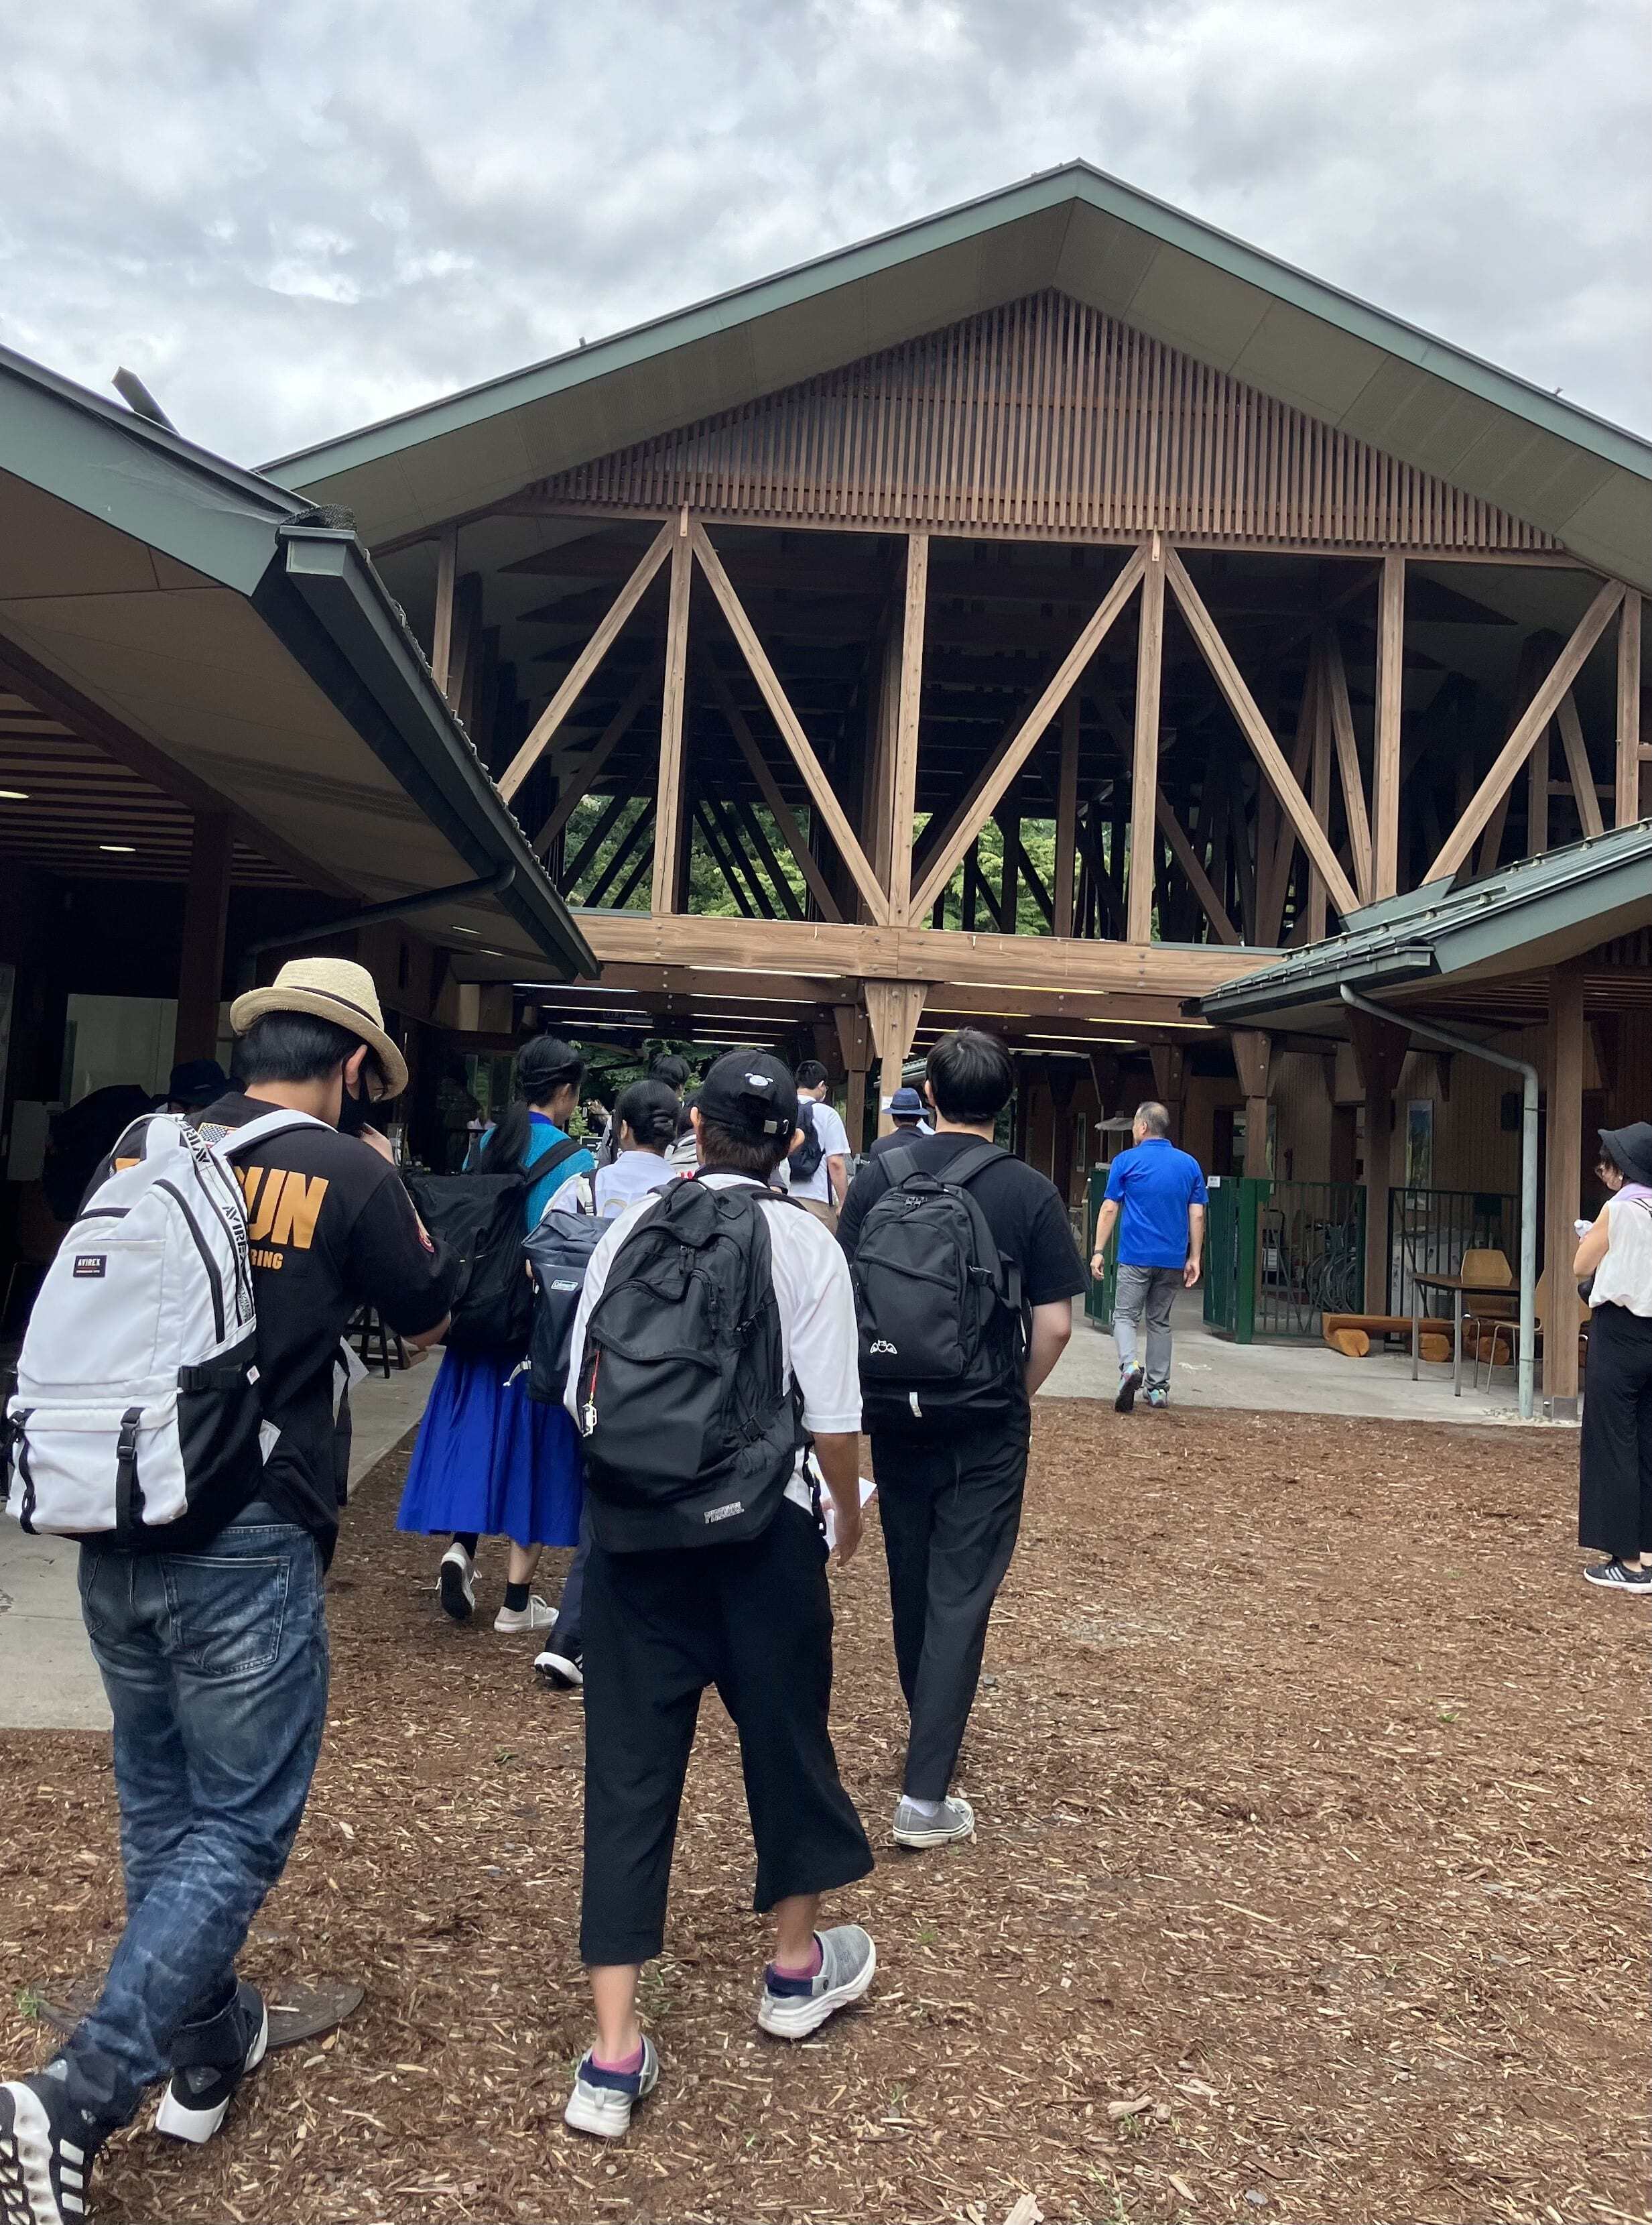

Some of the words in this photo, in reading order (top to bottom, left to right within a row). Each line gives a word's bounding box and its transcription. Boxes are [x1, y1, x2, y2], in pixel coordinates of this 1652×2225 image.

[235, 1166, 330, 1249] UN
[77, 1258, 101, 1266] AVIREX
[251, 1248, 283, 1270] RING
